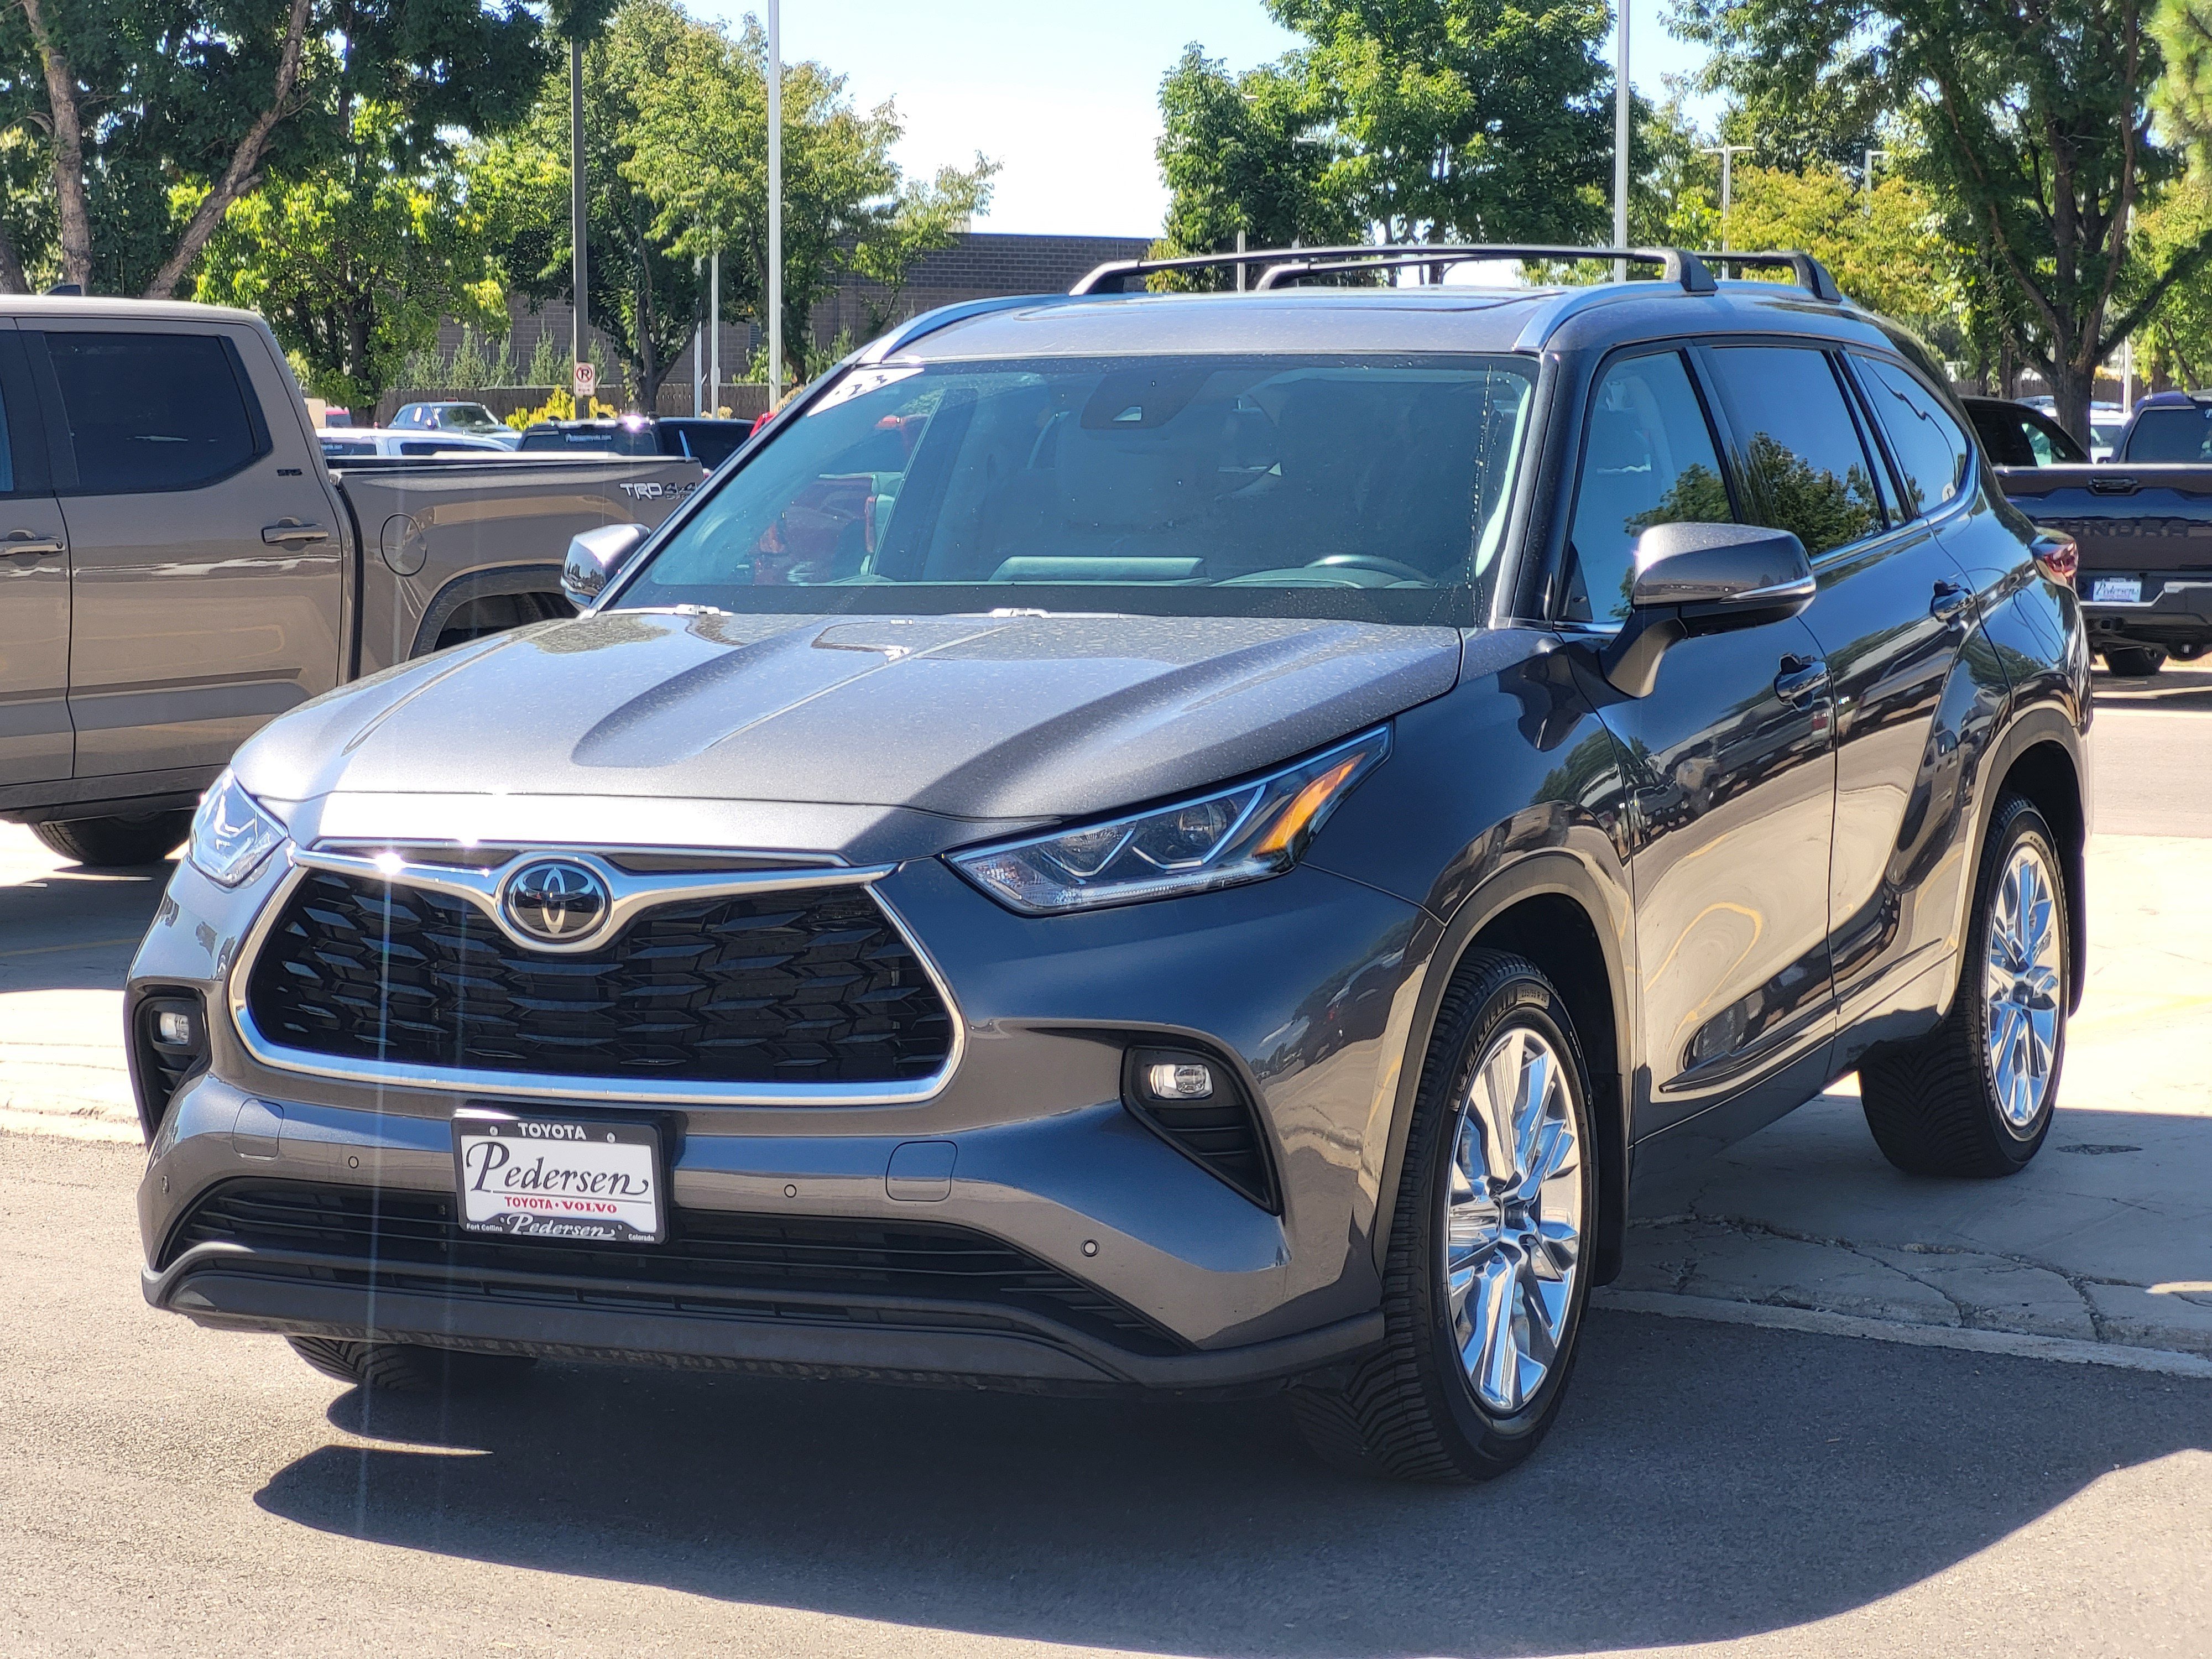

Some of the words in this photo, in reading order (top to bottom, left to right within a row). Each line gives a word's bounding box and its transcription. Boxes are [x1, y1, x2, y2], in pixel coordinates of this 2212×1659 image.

[619, 482, 662, 500] TRD
[2058, 519, 2189, 537] UNDRA
[518, 1123, 587, 1140] TOYOTA
[466, 1141, 649, 1195] Pedersen
[504, 1196, 553, 1210] TOYOTA
[561, 1201, 617, 1213] VOLVO
[481, 1223, 503, 1232] Collins
[507, 1212, 615, 1239] Pedersen
[628, 1233, 655, 1242] Colorado
